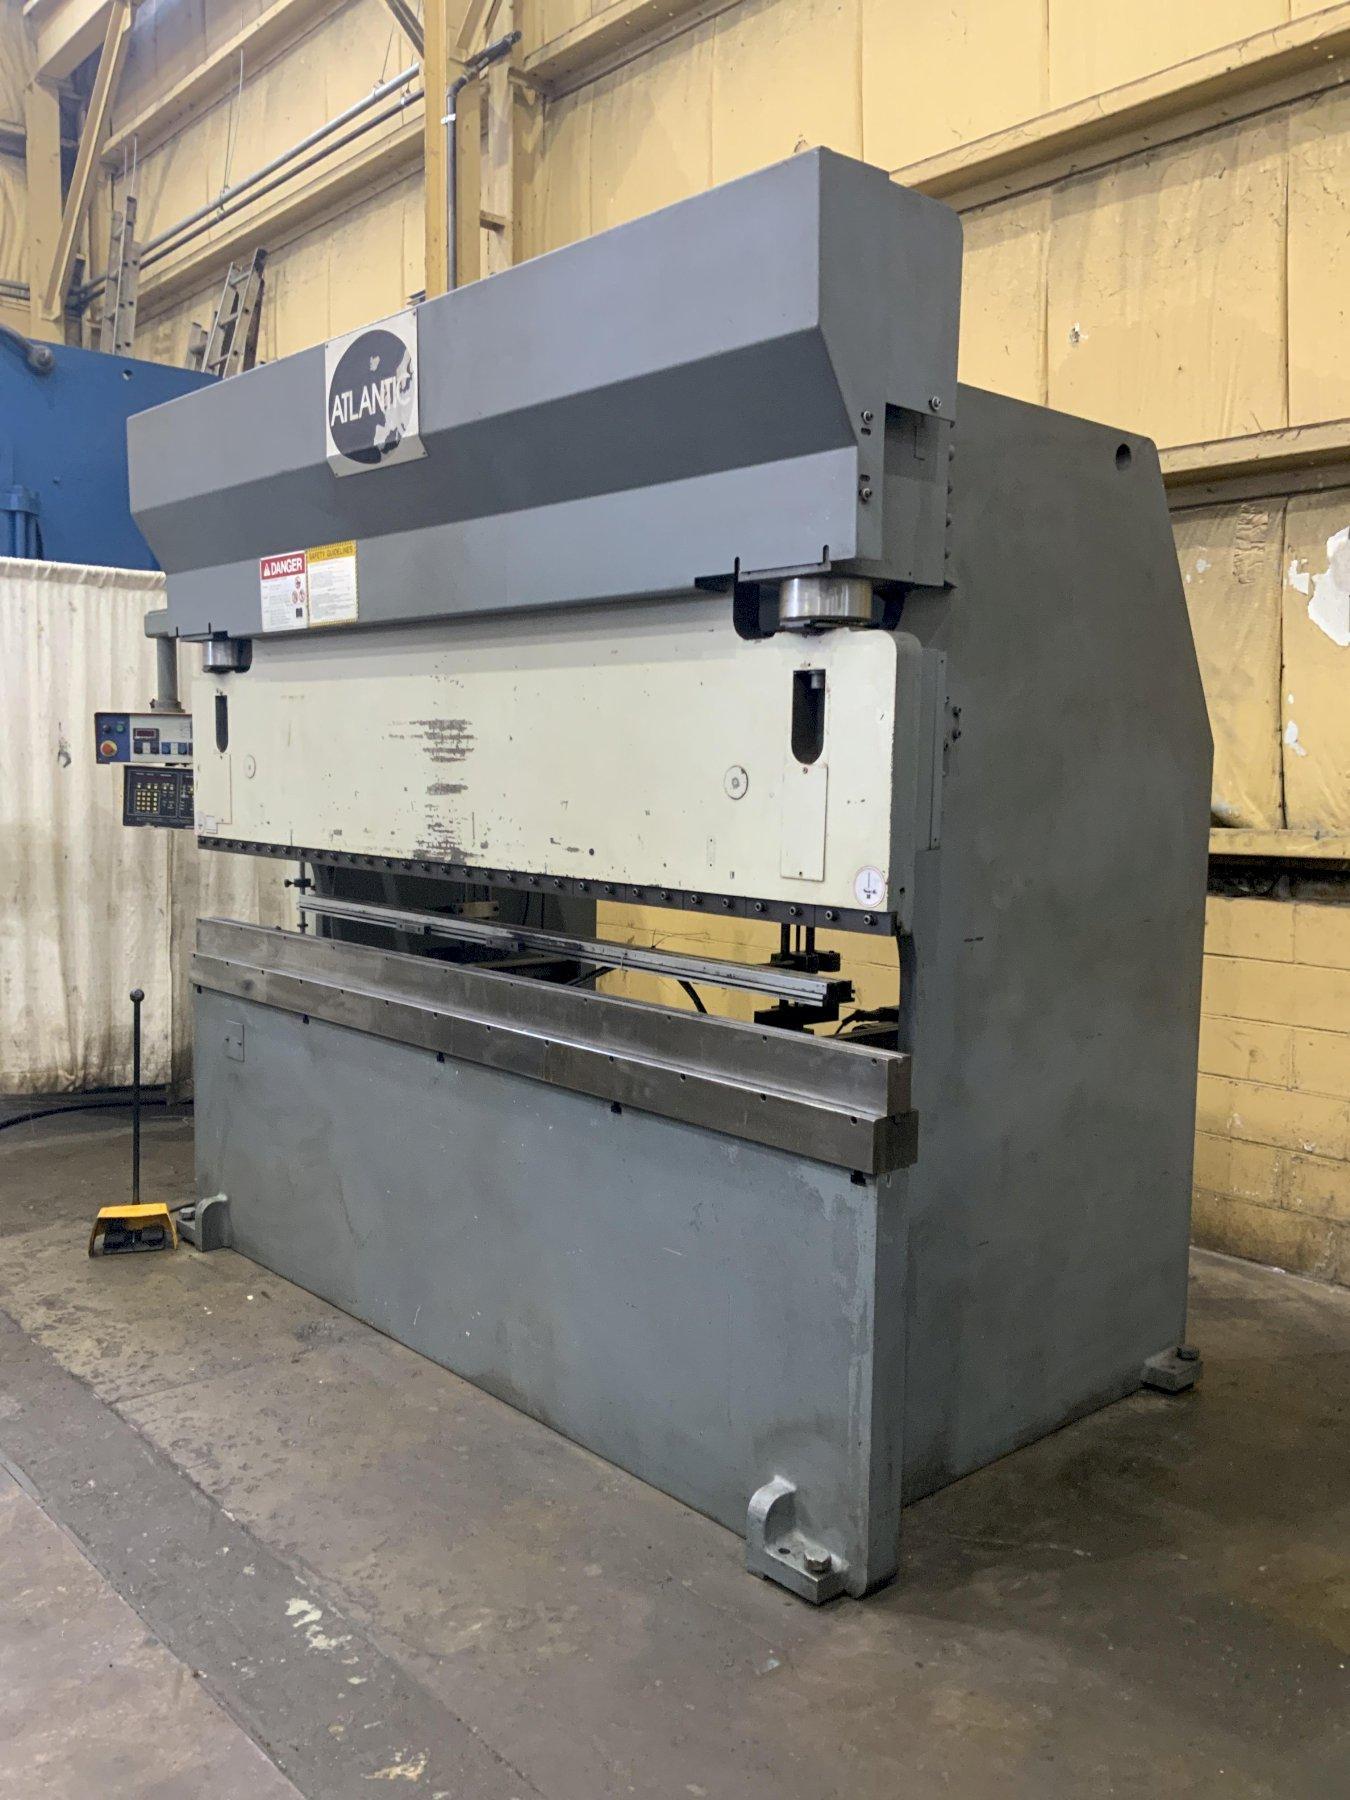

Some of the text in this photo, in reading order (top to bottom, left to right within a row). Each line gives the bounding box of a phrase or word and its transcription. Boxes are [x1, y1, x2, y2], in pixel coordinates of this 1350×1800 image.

[331, 375, 411, 427] ATLANTIC
[309, 545, 353, 560] SAFETY GUIDELINES
[271, 558, 303, 576] DANGER
